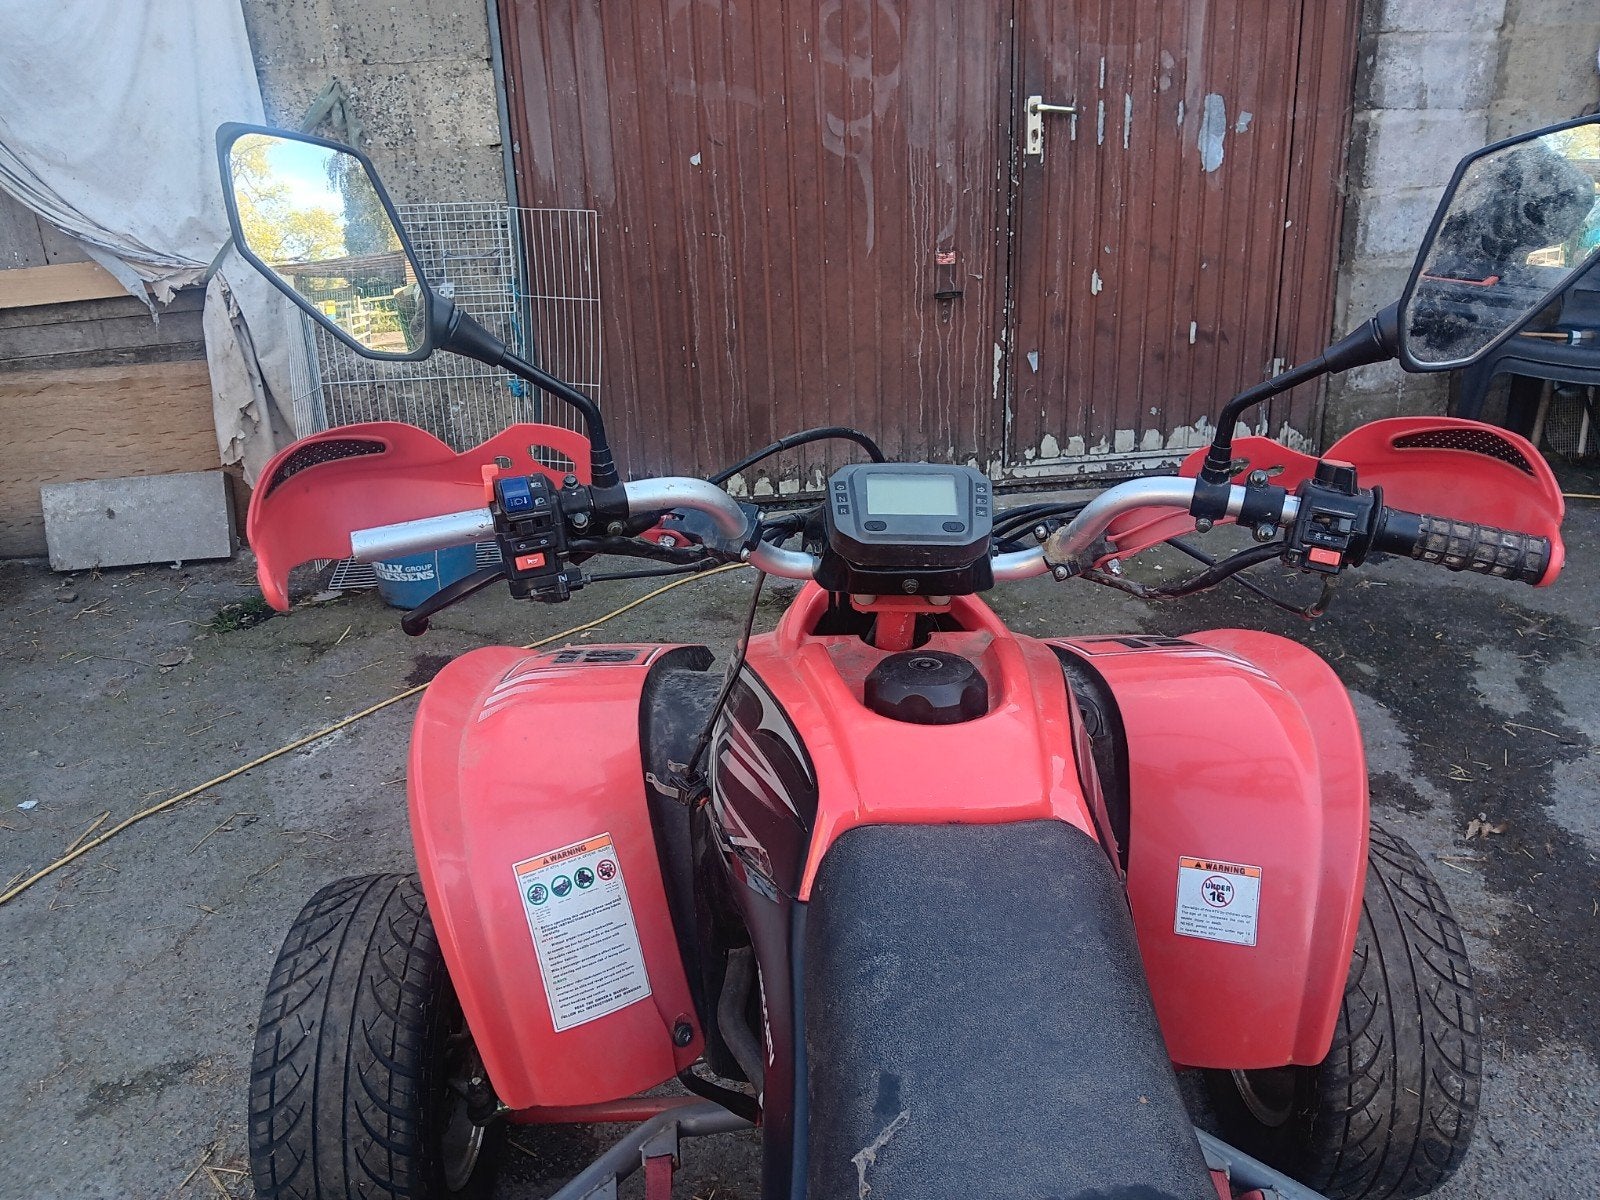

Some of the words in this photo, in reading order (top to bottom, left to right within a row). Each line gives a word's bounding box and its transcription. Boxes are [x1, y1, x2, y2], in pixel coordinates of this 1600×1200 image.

[405, 564, 432, 572] GROUP
[549, 844, 587, 862] WARNING
[1205, 863, 1245, 874] WARNING
[1205, 882, 1230, 891] UNDER
[1209, 891, 1225, 902] 16
